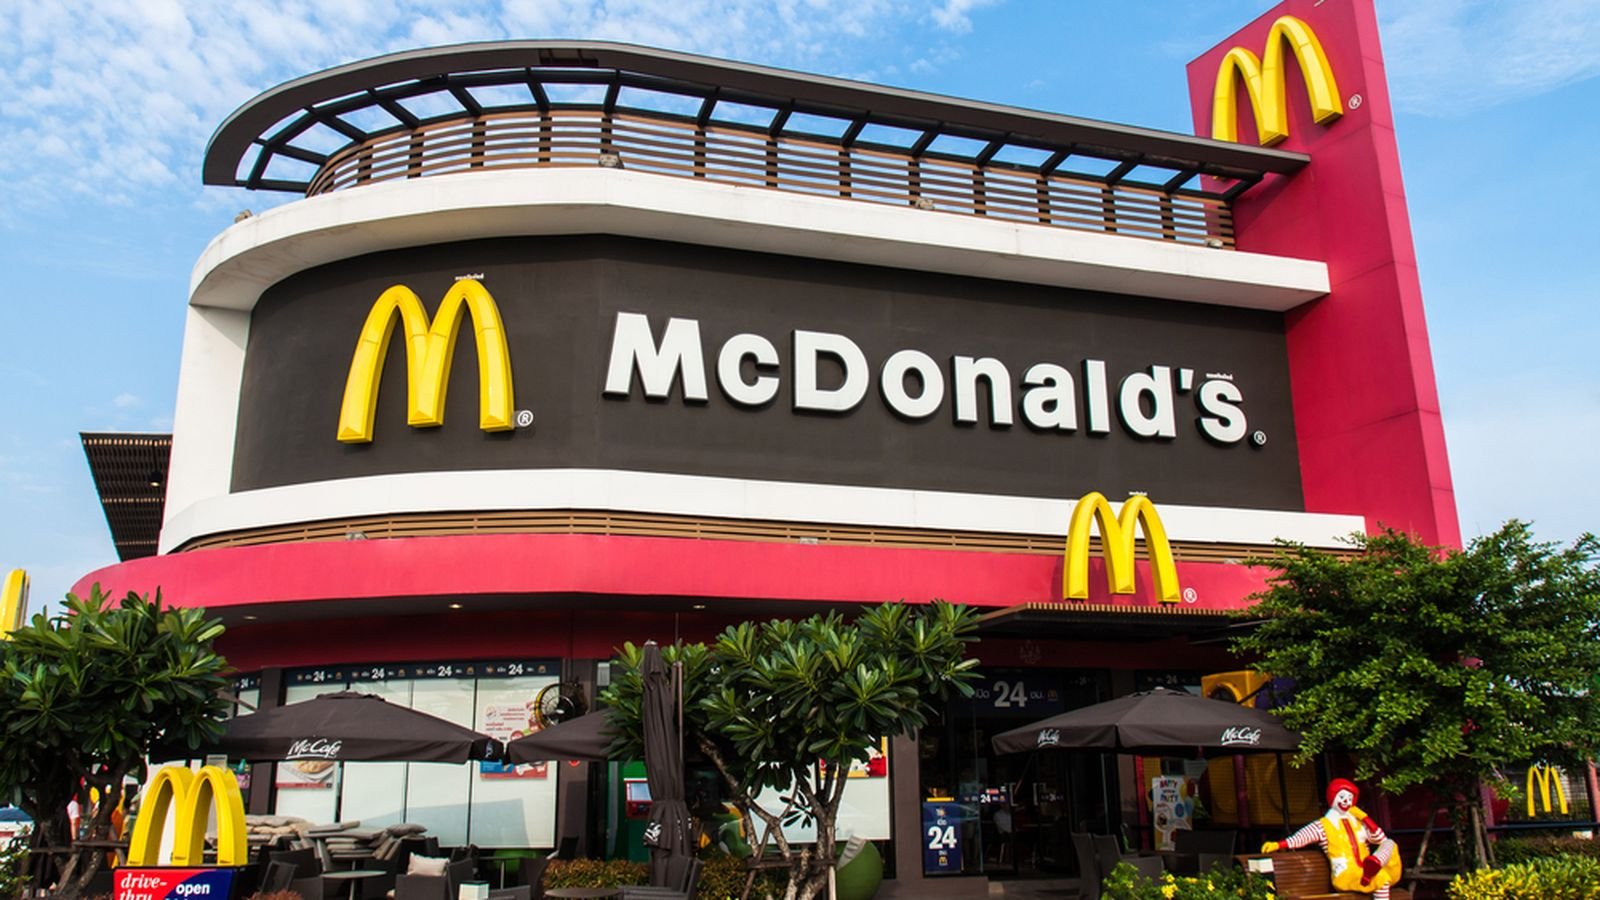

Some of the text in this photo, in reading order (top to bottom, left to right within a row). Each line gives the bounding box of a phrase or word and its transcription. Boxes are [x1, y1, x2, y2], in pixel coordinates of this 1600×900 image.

[337, 278, 515, 443] M
[602, 311, 1248, 446] McDonald's
[1063, 491, 1181, 603] M
[313, 671, 325, 682] 24
[371, 668, 385, 679] 24
[437, 666, 452, 677] 24
[508, 664, 523, 675] 24
[993, 681, 1027, 708] 24
[928, 825, 957, 850] 24
[120, 873, 168, 889] drive-
[175, 883, 211, 897] open
